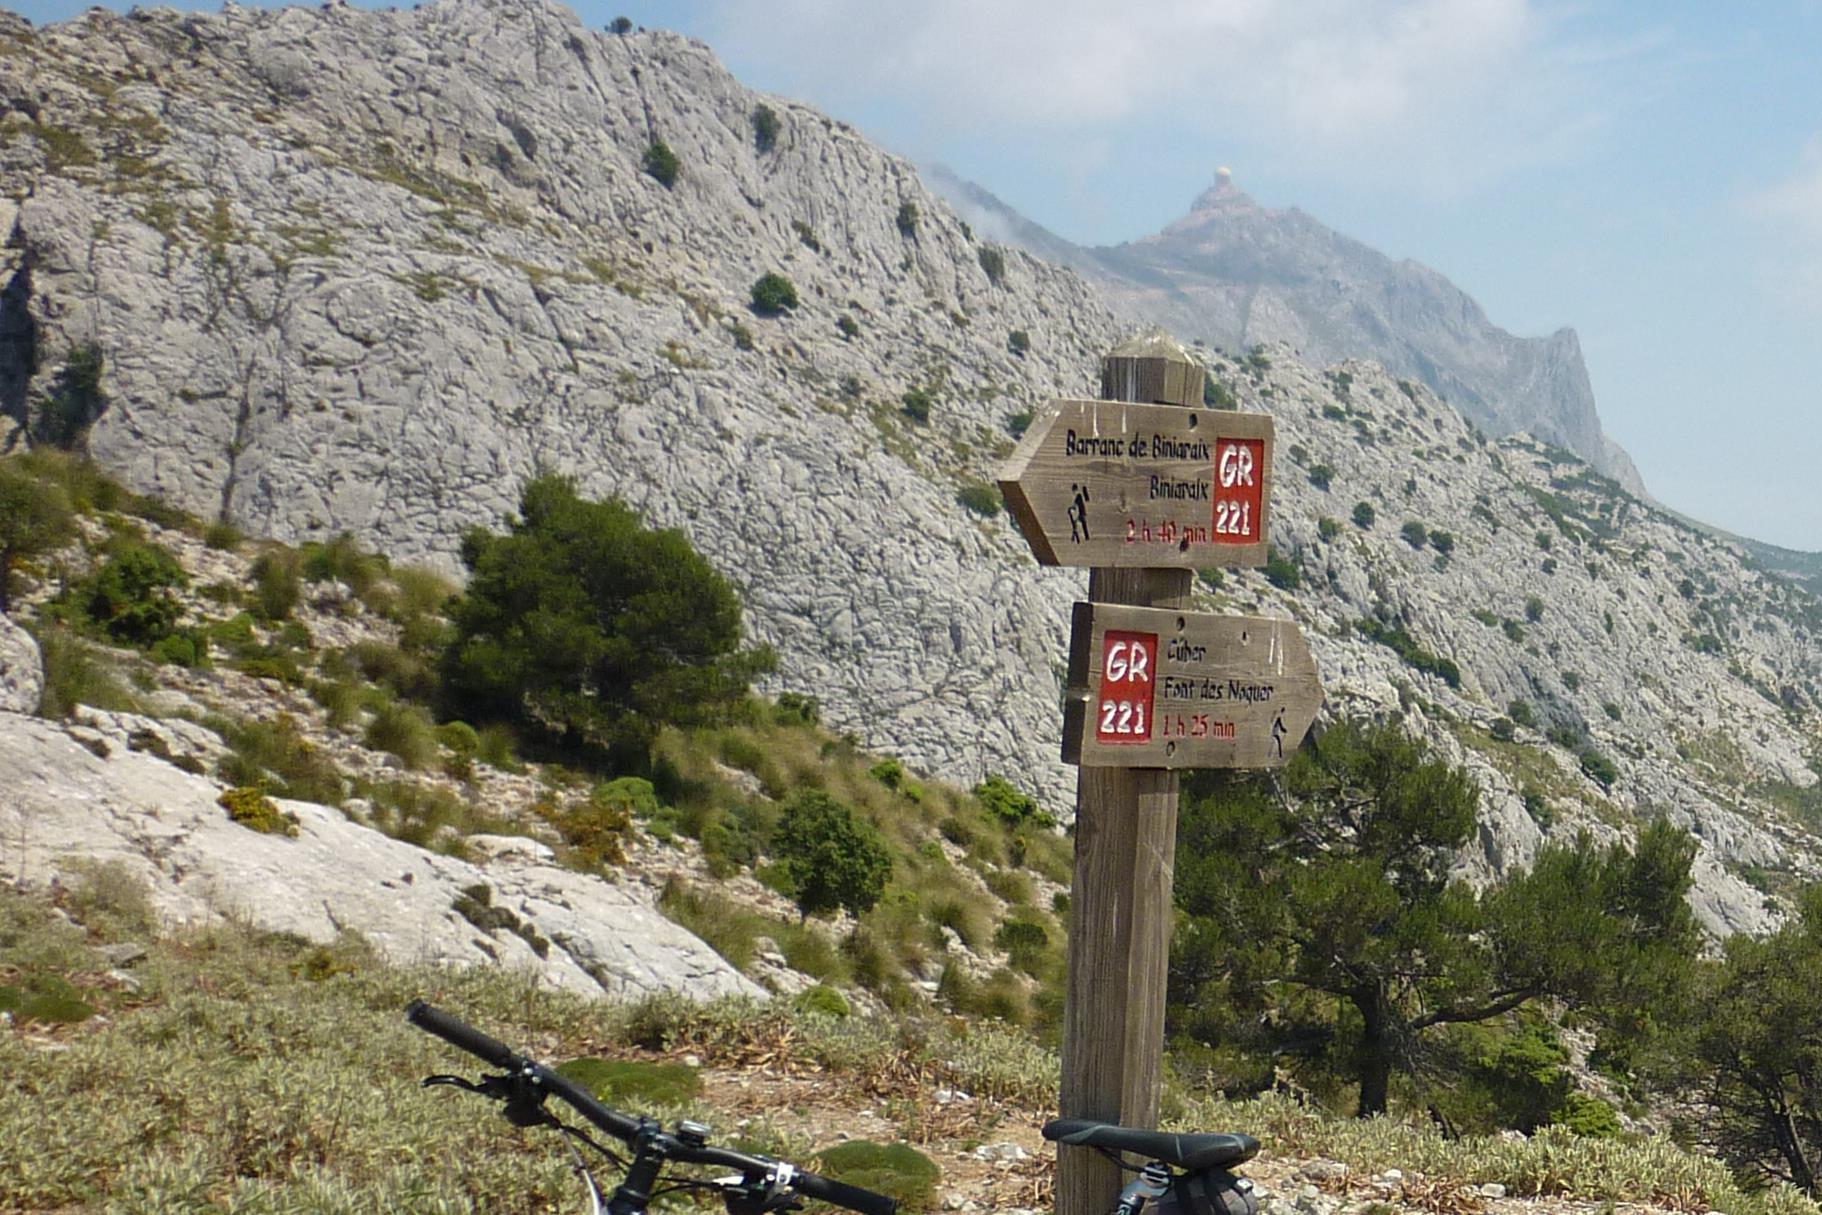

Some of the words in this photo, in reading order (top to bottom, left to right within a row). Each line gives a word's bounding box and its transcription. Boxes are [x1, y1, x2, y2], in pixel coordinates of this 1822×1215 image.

[1066, 429, 1124, 457] Barranc
[1129, 431, 1147, 459] de
[1152, 434, 1210, 461] Biniaraix
[1219, 443, 1254, 488] GR
[1150, 475, 1209, 501] Biniaraix
[1126, 519, 1136, 543] 2
[1142, 519, 1151, 543] h
[1157, 520, 1177, 544] 40
[1183, 522, 1206, 544] min
[1216, 500, 1251, 536] 221
[1106, 641, 1149, 682] GR
[1164, 676, 1195, 699] Font
[1201, 678, 1224, 700] des
[1100, 699, 1145, 734] 221
[1163, 714, 1170, 736] 1
[1176, 713, 1185, 736] h
[1191, 714, 1208, 737] 25
[1213, 714, 1235, 738] min
